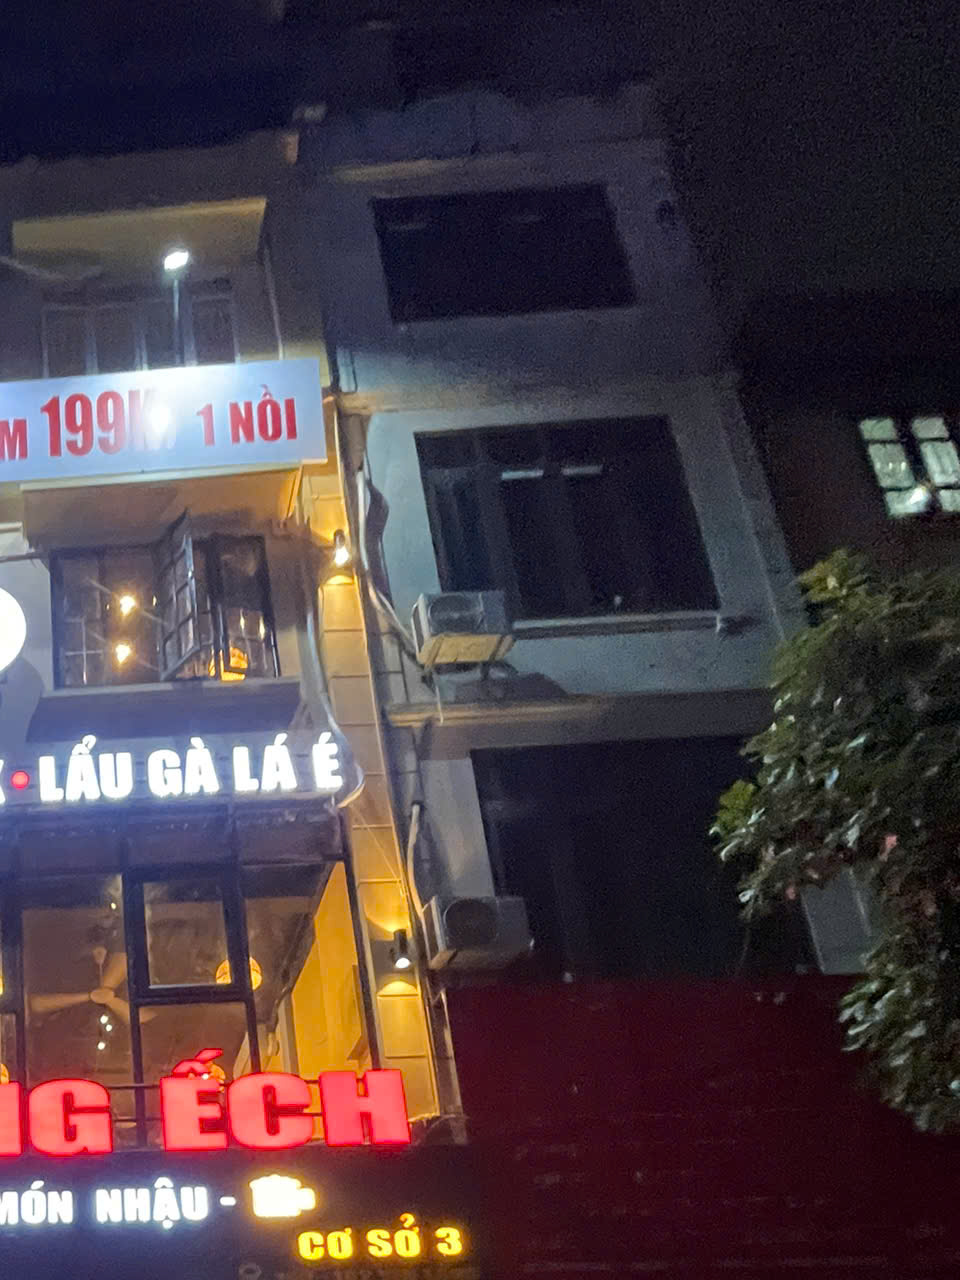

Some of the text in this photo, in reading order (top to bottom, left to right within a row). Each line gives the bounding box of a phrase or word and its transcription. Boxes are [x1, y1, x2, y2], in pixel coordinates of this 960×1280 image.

[197, 404, 215, 446] 1
[229, 384, 297, 444] NỒI
[39, 735, 133, 801] LẨU
[148, 737, 220, 797] GÀ
[233, 733, 297, 792] LÁ
[312, 732, 343, 790] É
[160, 1048, 411, 1151] ẾCH
[96, 1177, 208, 1229] NHẬU
[366, 1213, 420, 1258] SỞ
[435, 1227, 462, 1255] 3
